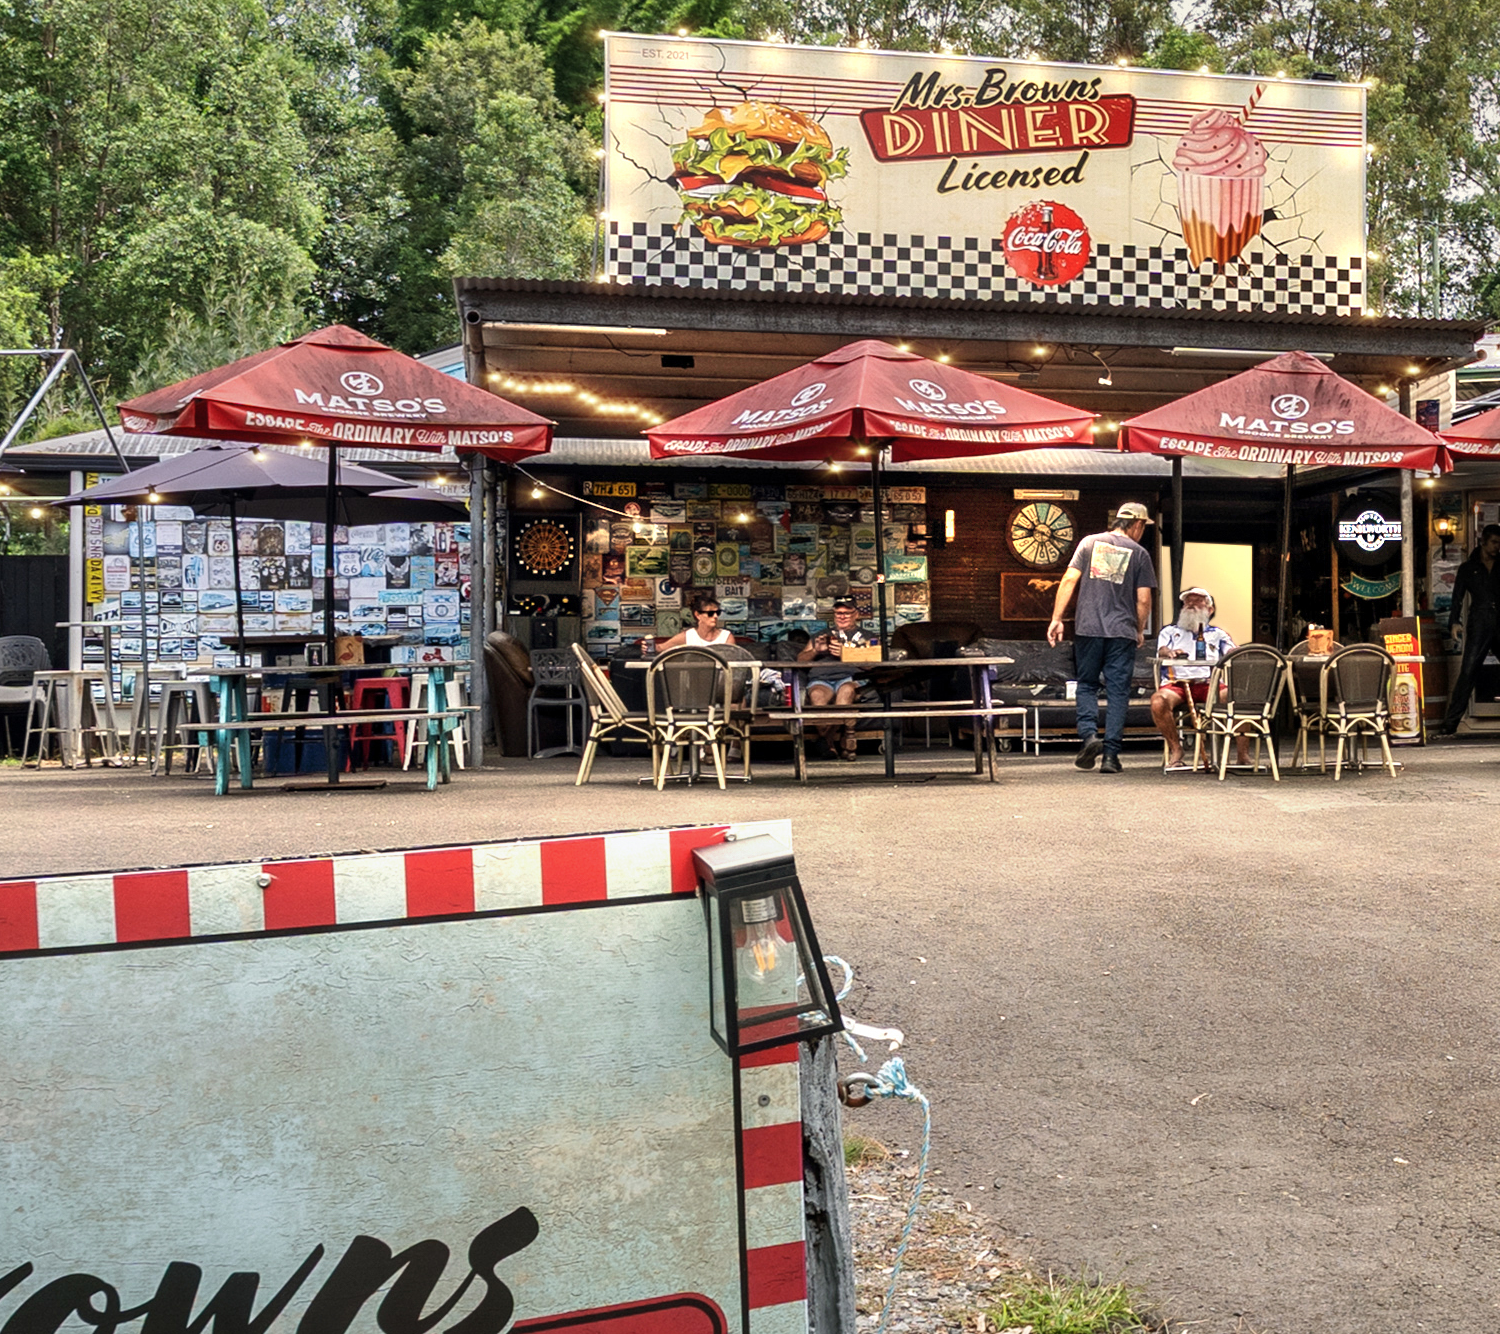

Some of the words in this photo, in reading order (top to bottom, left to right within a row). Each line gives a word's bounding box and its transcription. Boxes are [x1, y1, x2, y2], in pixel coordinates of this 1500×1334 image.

[642, 47, 663, 59] EST.
[666, 49, 690, 60] 2021
[890, 71, 972, 113] Mrs.
[974, 68, 1102, 107] Browns
[882, 103, 1110, 157] DINER
[937, 149, 1090, 194] Licensed
[294, 387, 447, 414] MATSO'S
[893, 396, 1007, 415] MATSO'S
[332, 423, 415, 445] ORDINARY
[448, 428, 514, 446] MATSO'S
[1219, 412, 1355, 435] MATSO'S
[1158, 436, 1214, 457] ESCAPE
[1238, 445, 1314, 465] ORDINARY
[1342, 449, 1405, 466] MATSO'S
[343, 565, 358, 575] 66
